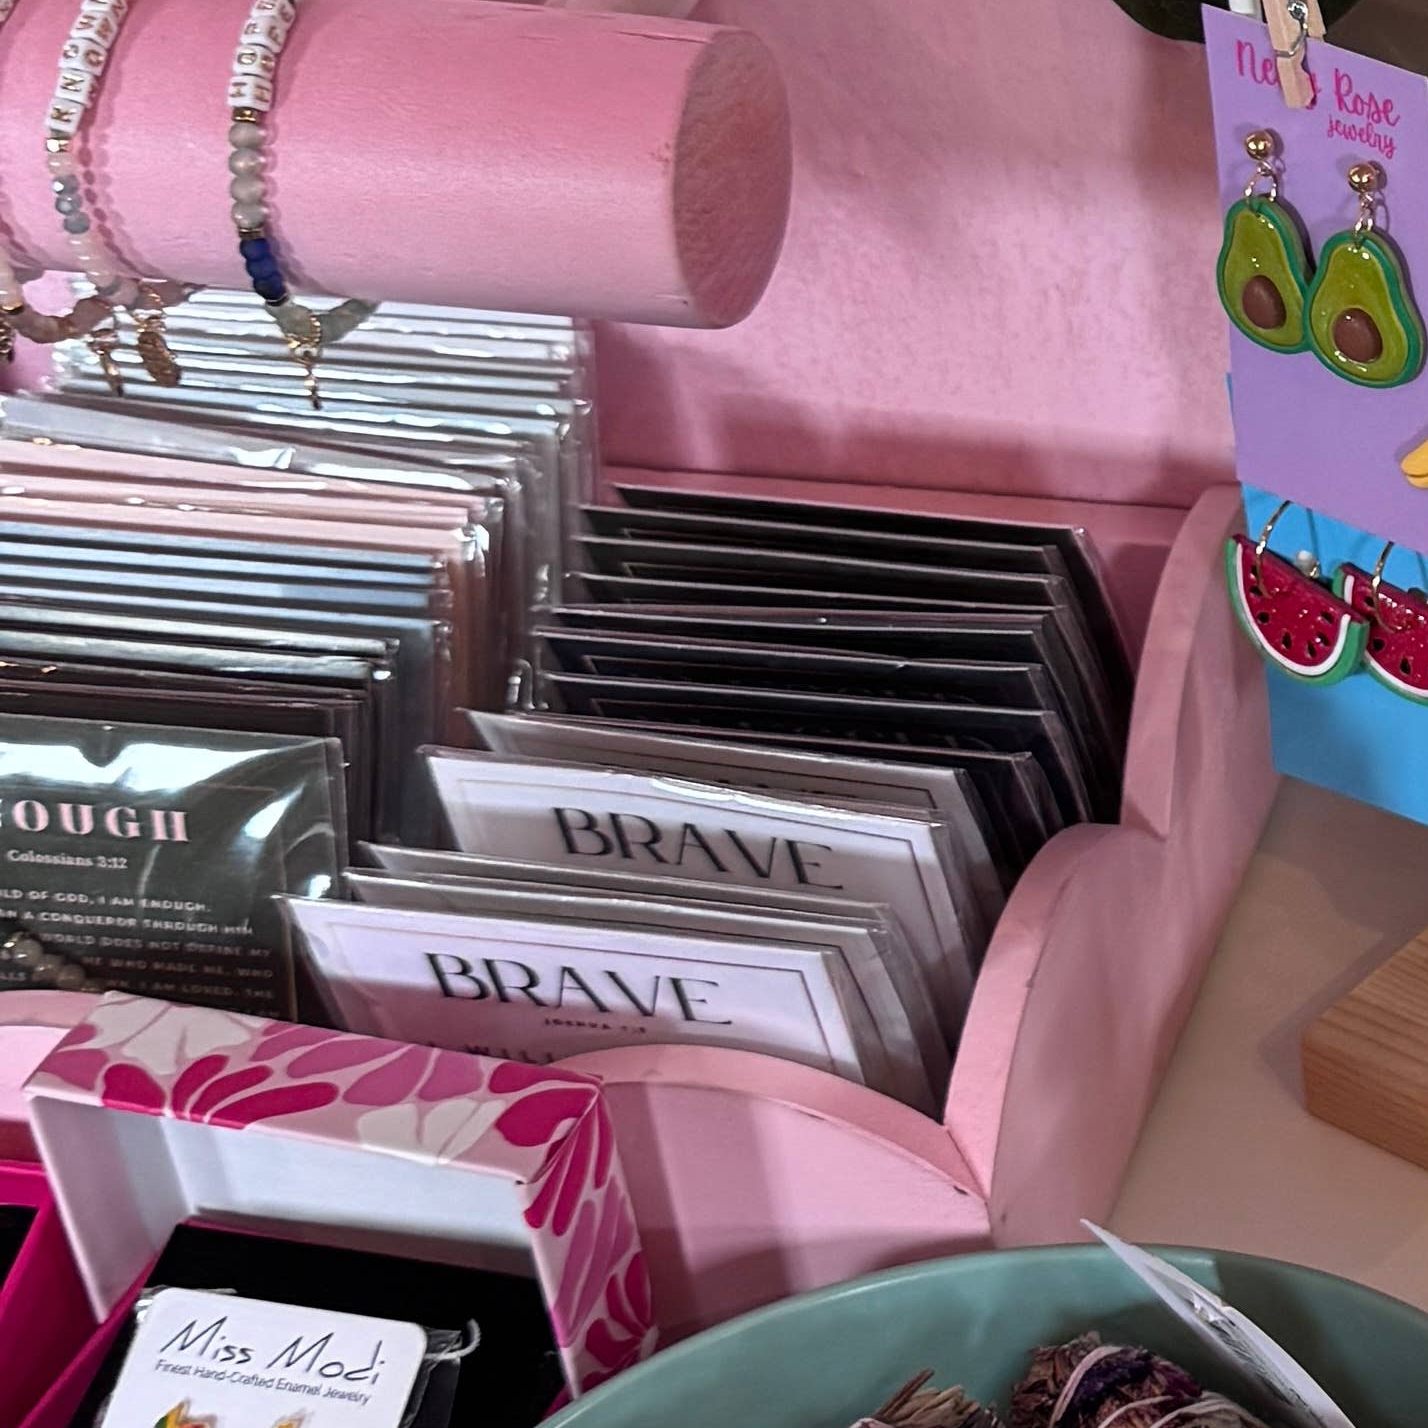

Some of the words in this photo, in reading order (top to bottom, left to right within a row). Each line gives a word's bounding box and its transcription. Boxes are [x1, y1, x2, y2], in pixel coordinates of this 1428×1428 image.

[1334, 68, 1401, 128] Rose
[1328, 115, 1397, 160] jewelry
[0, 799, 190, 843] OUGH
[552, 805, 844, 890] BRAVE
[6, 847, 94, 867] Colossians
[424, 951, 733, 1026] BRAVE
[159, 1315, 255, 1362] Miss
[265, 1331, 386, 1386] Modi
